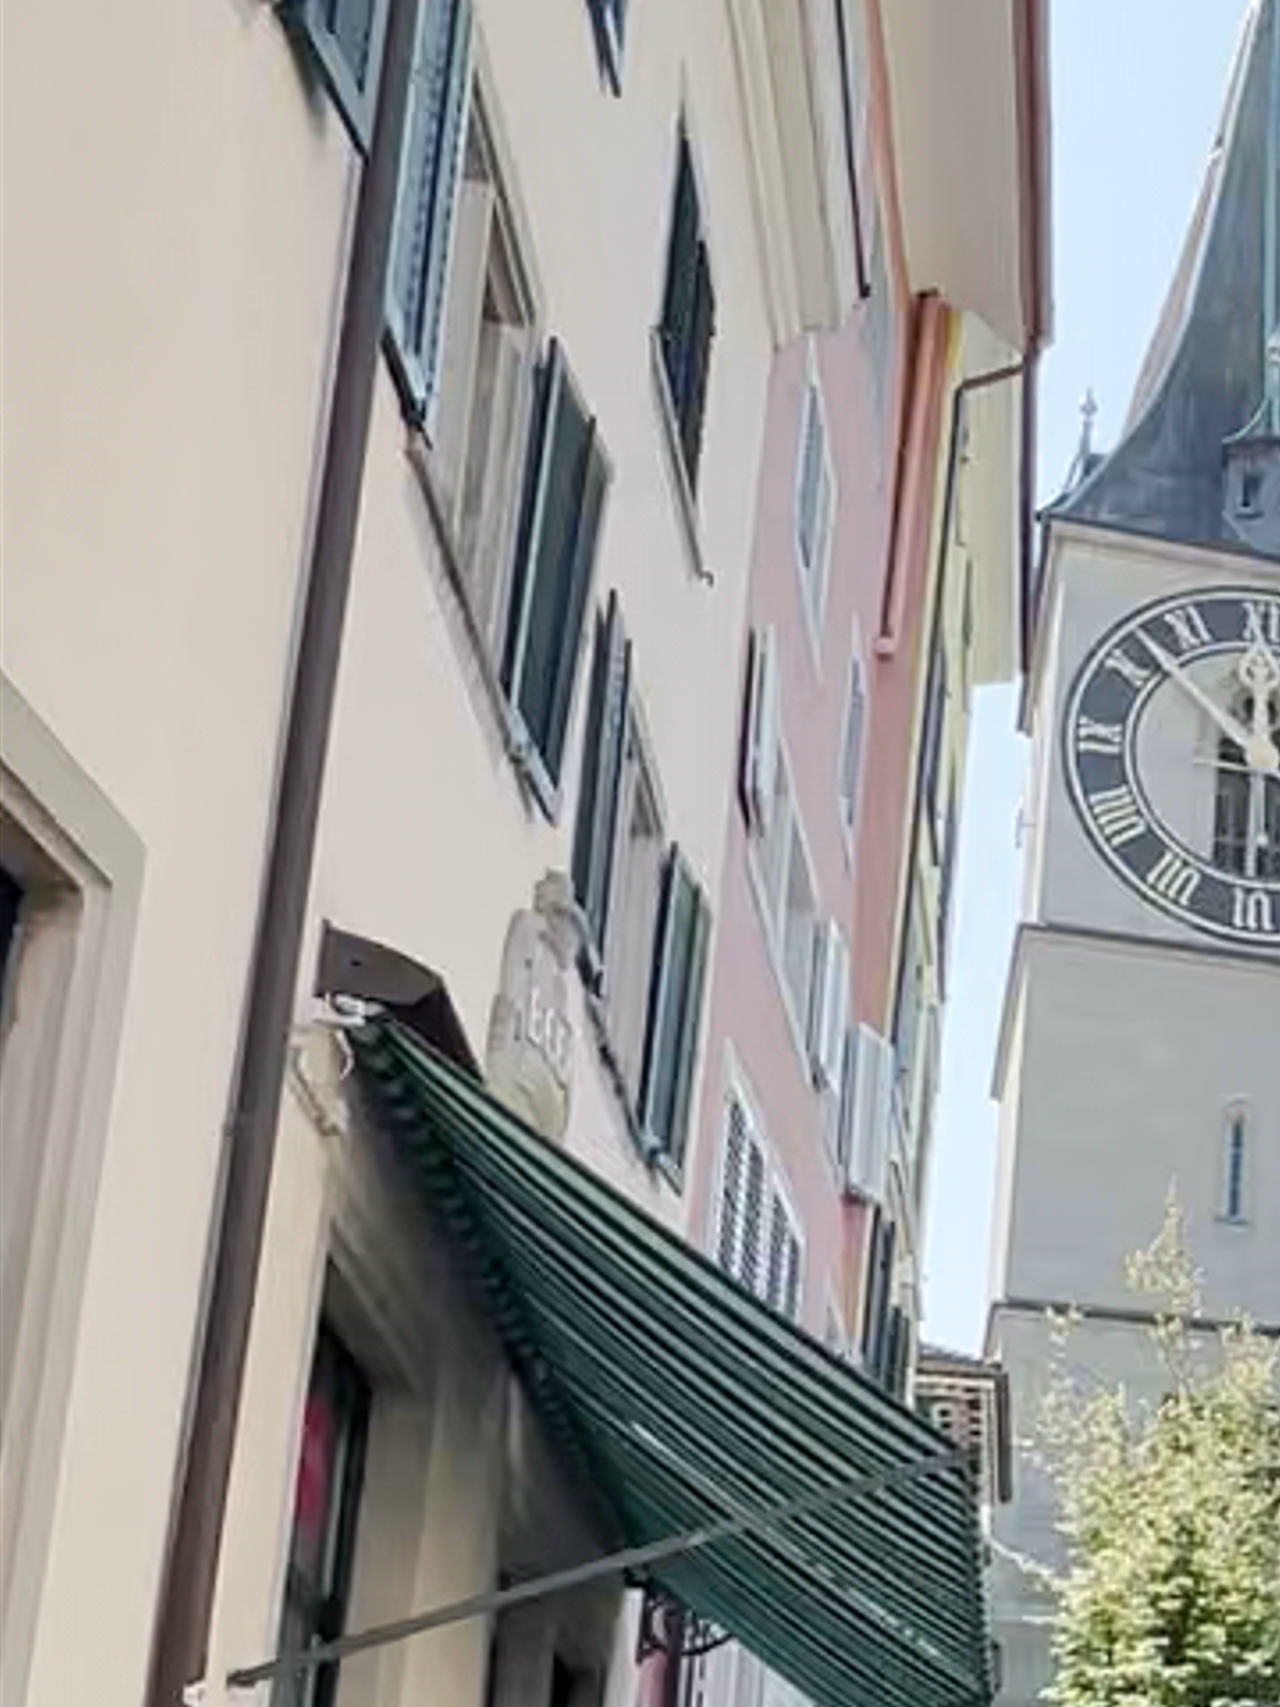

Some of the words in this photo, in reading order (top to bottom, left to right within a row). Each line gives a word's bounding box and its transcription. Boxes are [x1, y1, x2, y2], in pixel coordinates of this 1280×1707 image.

[1164, 605, 1212, 649] XI
[1104, 648, 1151, 686] X
[1079, 715, 1122, 754] IX
